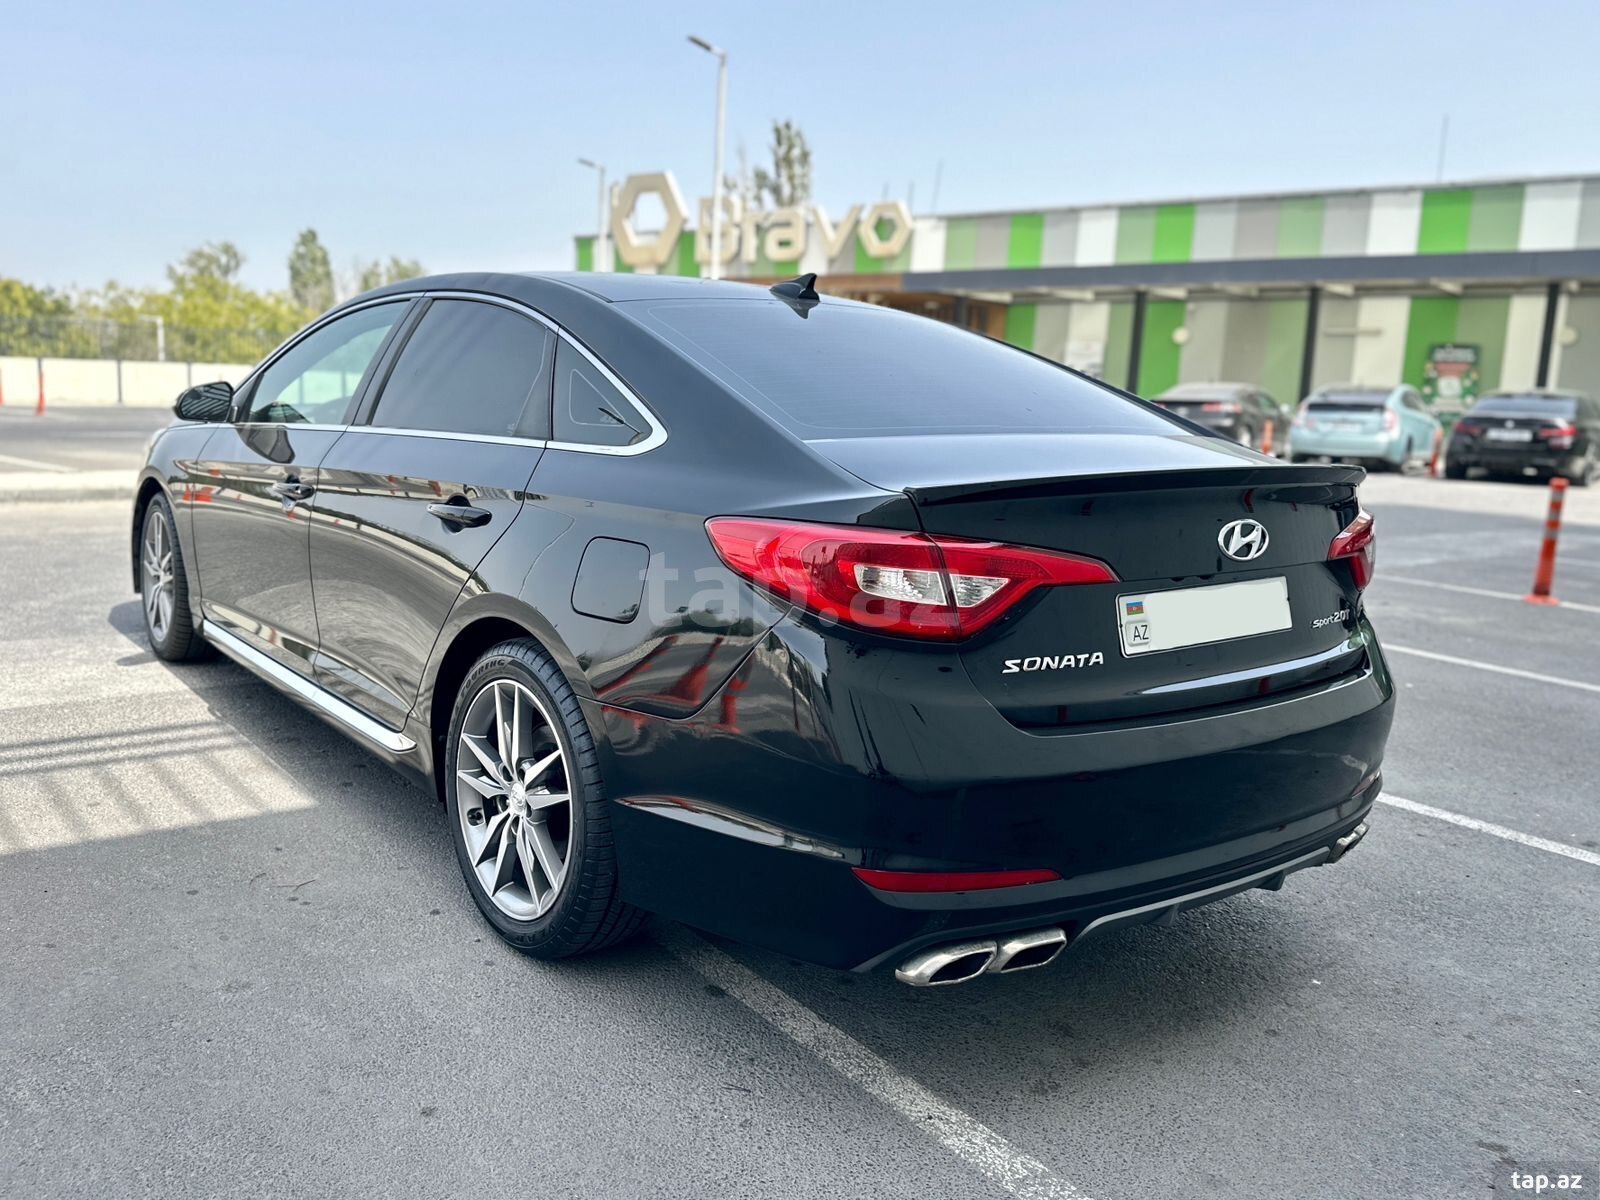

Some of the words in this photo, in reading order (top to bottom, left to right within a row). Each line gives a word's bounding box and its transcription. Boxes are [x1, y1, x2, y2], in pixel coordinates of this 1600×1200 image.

[696, 196, 913, 264] Bravo
[1132, 624, 1149, 641] AZ
[1002, 651, 1104, 674] SONATA
